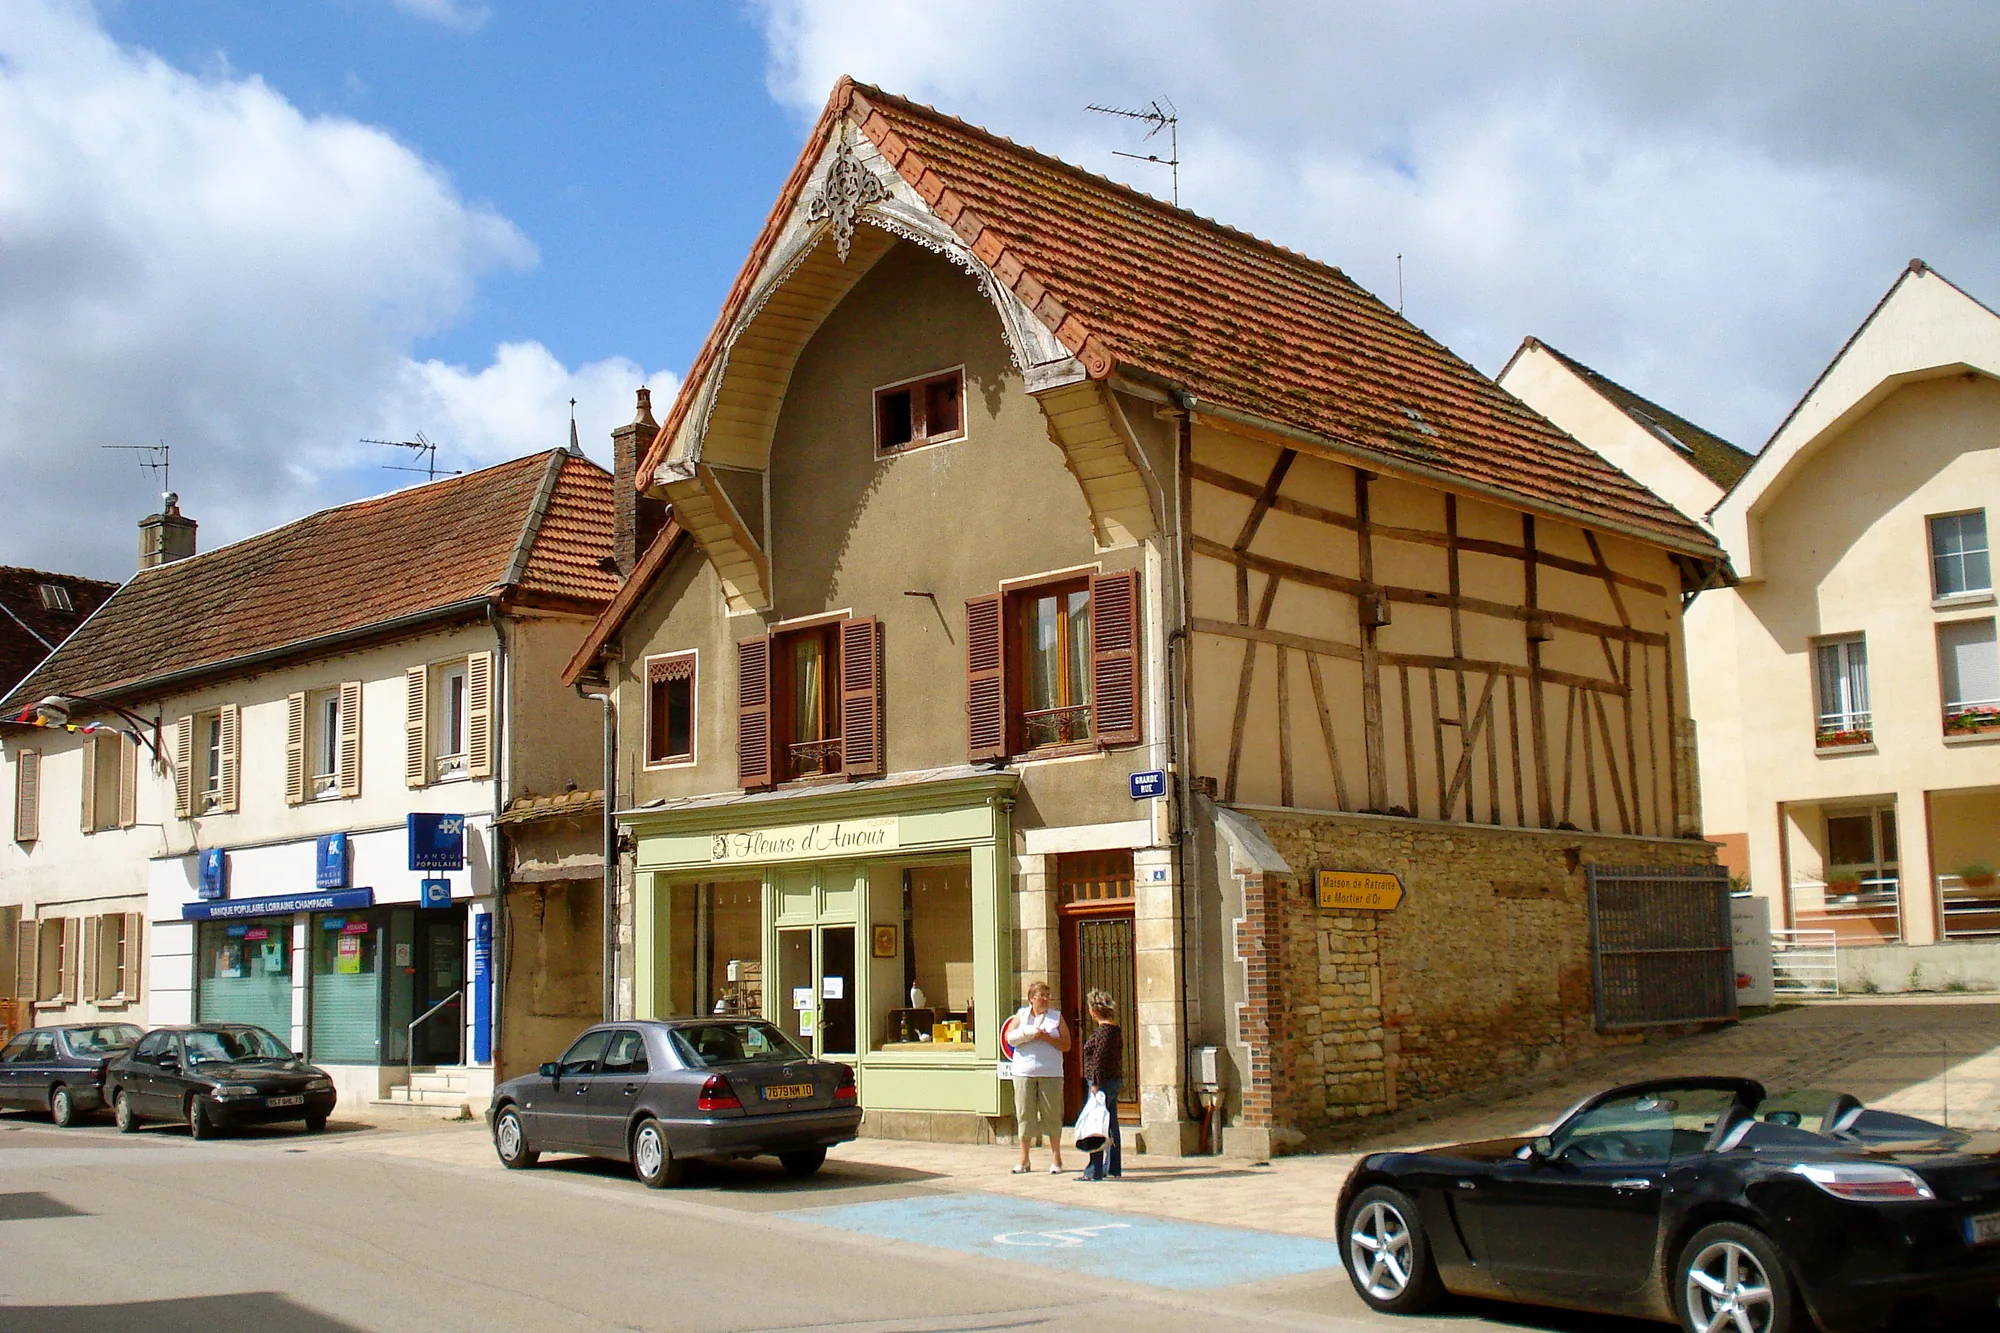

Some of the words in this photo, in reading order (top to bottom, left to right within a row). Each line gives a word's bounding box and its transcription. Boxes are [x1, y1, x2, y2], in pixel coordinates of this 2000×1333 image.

[1134, 774, 1159, 785] GRANDE
[1140, 784, 1154, 793] RUE
[733, 832, 796, 858] Fleurs
[801, 824, 886, 851] d'Amour
[1322, 876, 1351, 889] Maison
[1352, 878, 1362, 889] de
[1364, 878, 1396, 890] Retraite
[1322, 892, 1332, 903] Le
[1334, 892, 1363, 904] Mortier
[1365, 893, 1382, 904] d'Or
[210, 906, 234, 917] BANQUE
[234, 903, 265, 915] POPULAIRE
[265, 900, 294, 912] LORRAINE
[295, 898, 334, 910] CHAMPAGNE
[767, 1086, 788, 1098] 7679
[789, 1085, 801, 1096] NM
[802, 1085, 812, 1095] 10
